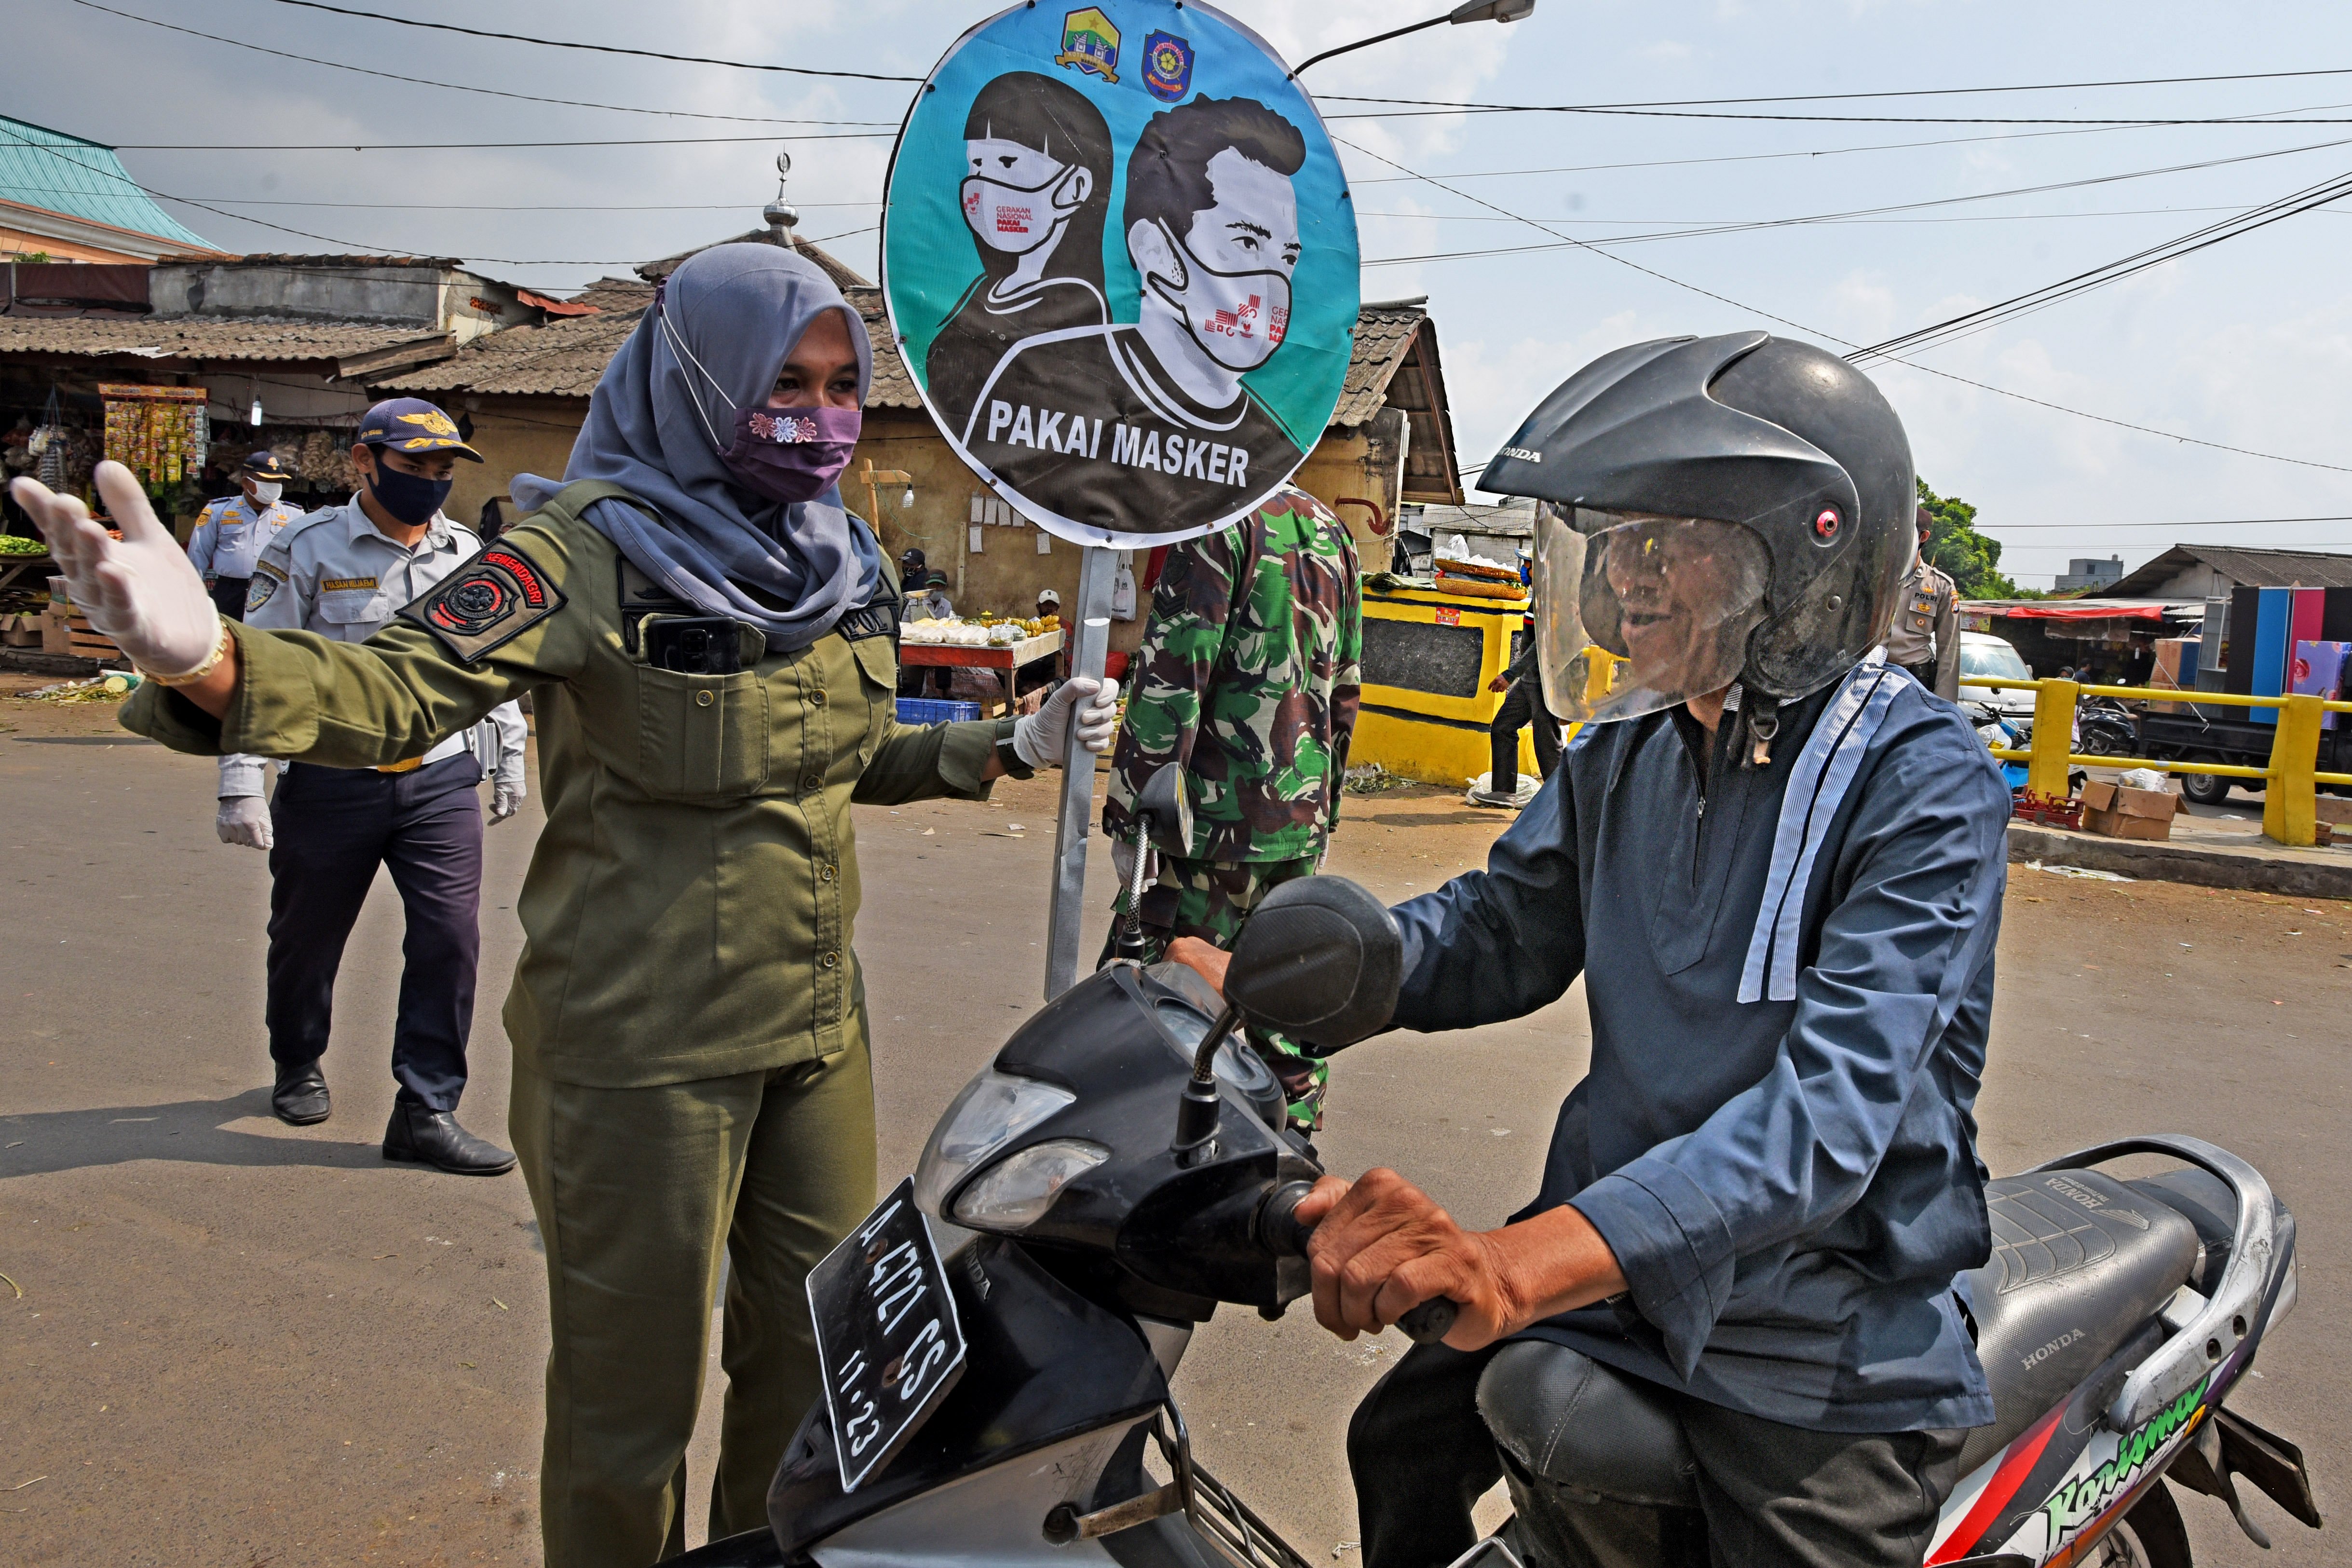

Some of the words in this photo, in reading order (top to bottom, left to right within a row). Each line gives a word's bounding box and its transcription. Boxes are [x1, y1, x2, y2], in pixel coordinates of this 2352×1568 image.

[996, 205, 1031, 214] GERAKAN
[996, 212, 1033, 221] NASIONAL
[996, 218, 1020, 227] PAKAI
[987, 399, 1103, 460] PAKAI
[1111, 423, 1249, 488] MASKER
[326, 580, 349, 589] HASAN
[482, 552, 544, 603] KEMENDAGRI
[1914, 592, 1938, 602] POLRI
[2044, 1178, 2104, 1209] HONDA
[860, 1200, 902, 1248] A
[868, 1240, 927, 1336] 4721
[897, 1318, 946, 1400] CS
[2021, 1328, 2086, 1371] HONDA
